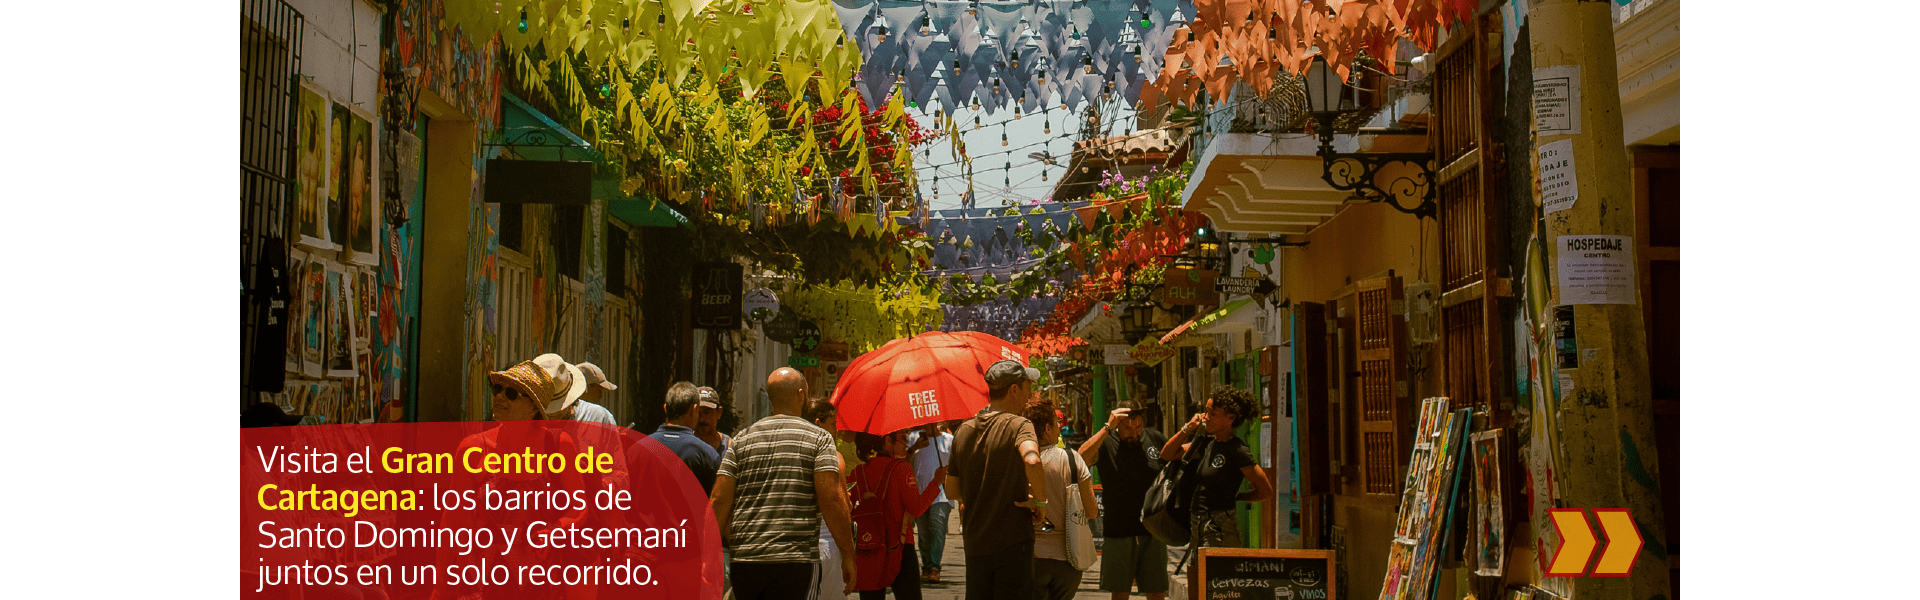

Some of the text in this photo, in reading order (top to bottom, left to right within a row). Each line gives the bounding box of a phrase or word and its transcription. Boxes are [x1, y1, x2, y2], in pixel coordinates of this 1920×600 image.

[1567, 238, 1622, 251] HOSPEDAJE
[1222, 285, 1255, 294] LAUNDRY
[701, 294, 732, 305] BEER
[908, 389, 937, 405] FREE
[910, 402, 940, 419] TOUR
[1211, 577, 1270, 588] Cervezas
